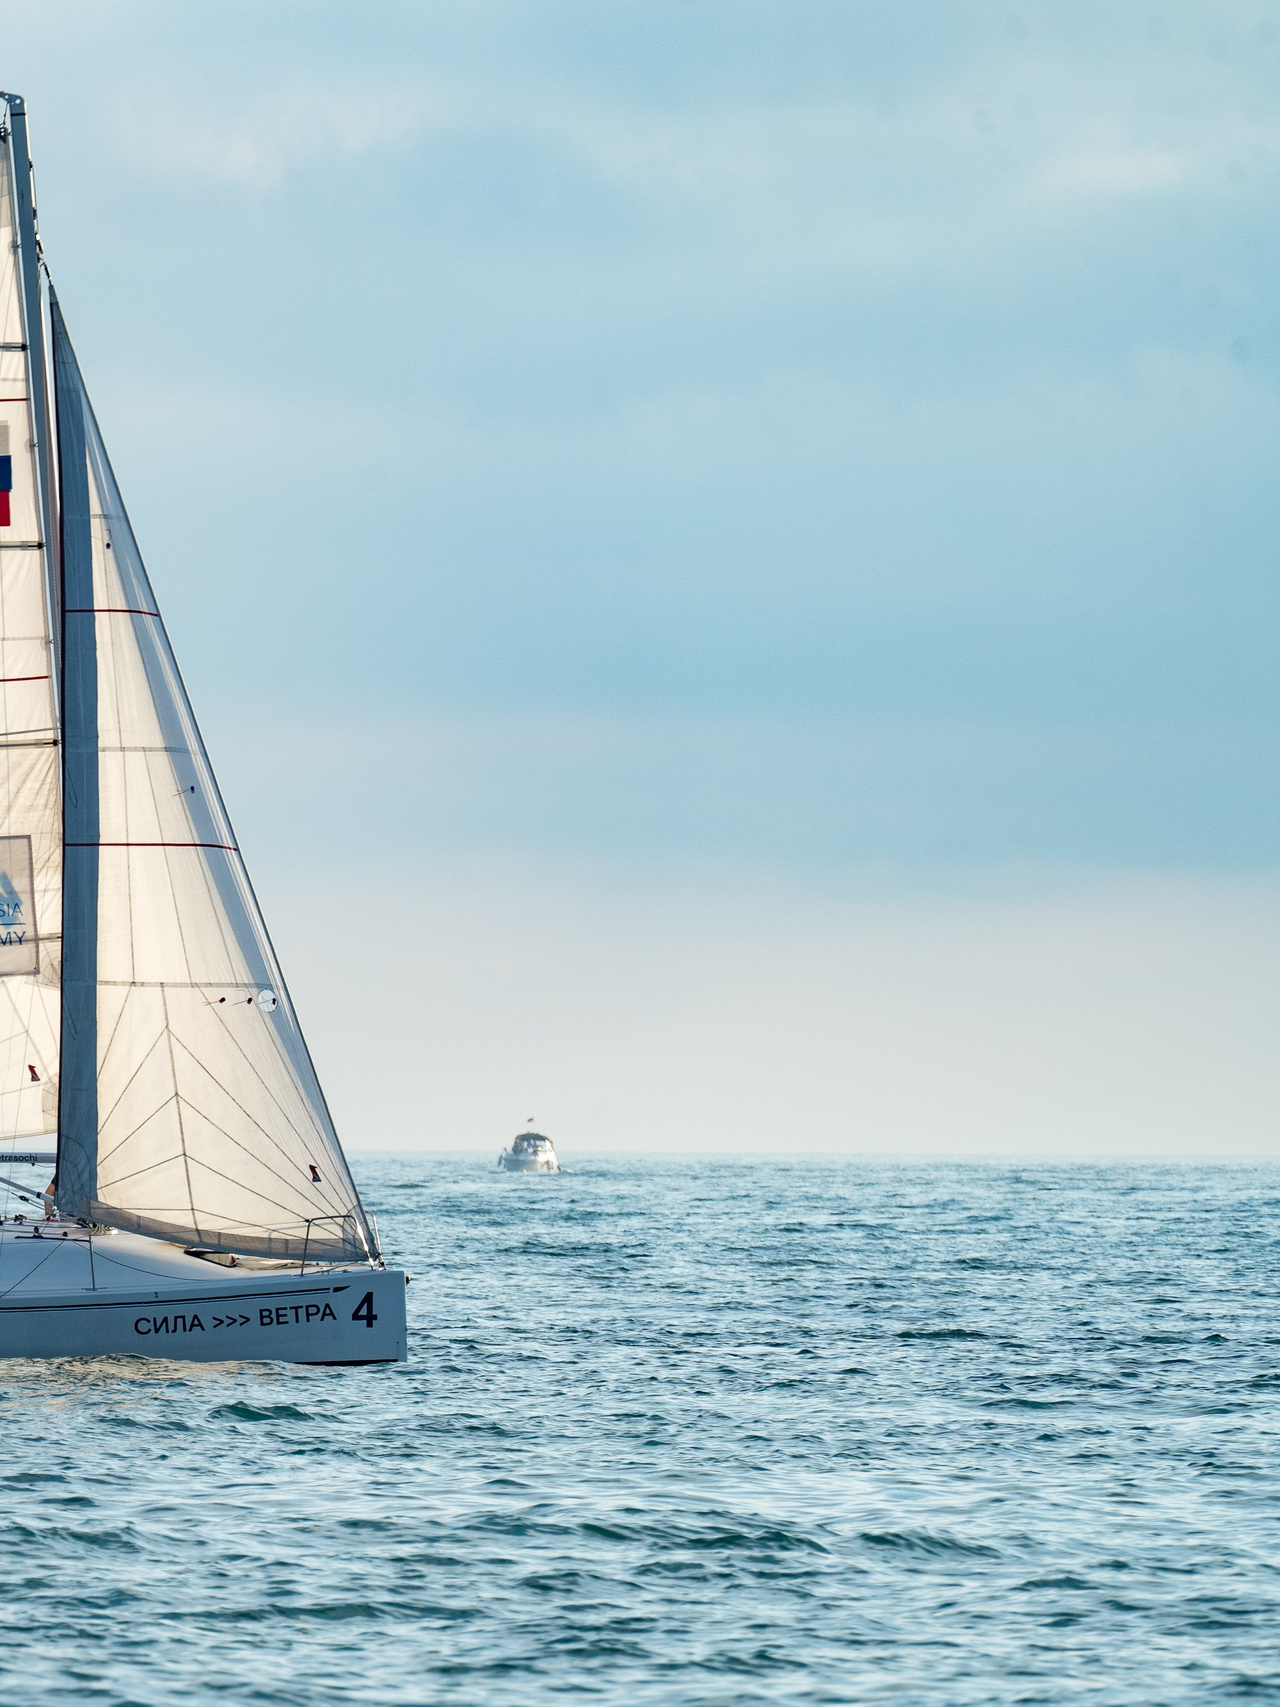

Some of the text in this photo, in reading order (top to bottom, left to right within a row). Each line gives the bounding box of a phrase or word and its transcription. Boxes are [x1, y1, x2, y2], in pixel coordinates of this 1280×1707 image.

[133, 1302, 338, 1336] СИЛА ВЕТРА
[351, 1291, 378, 1328] 4
